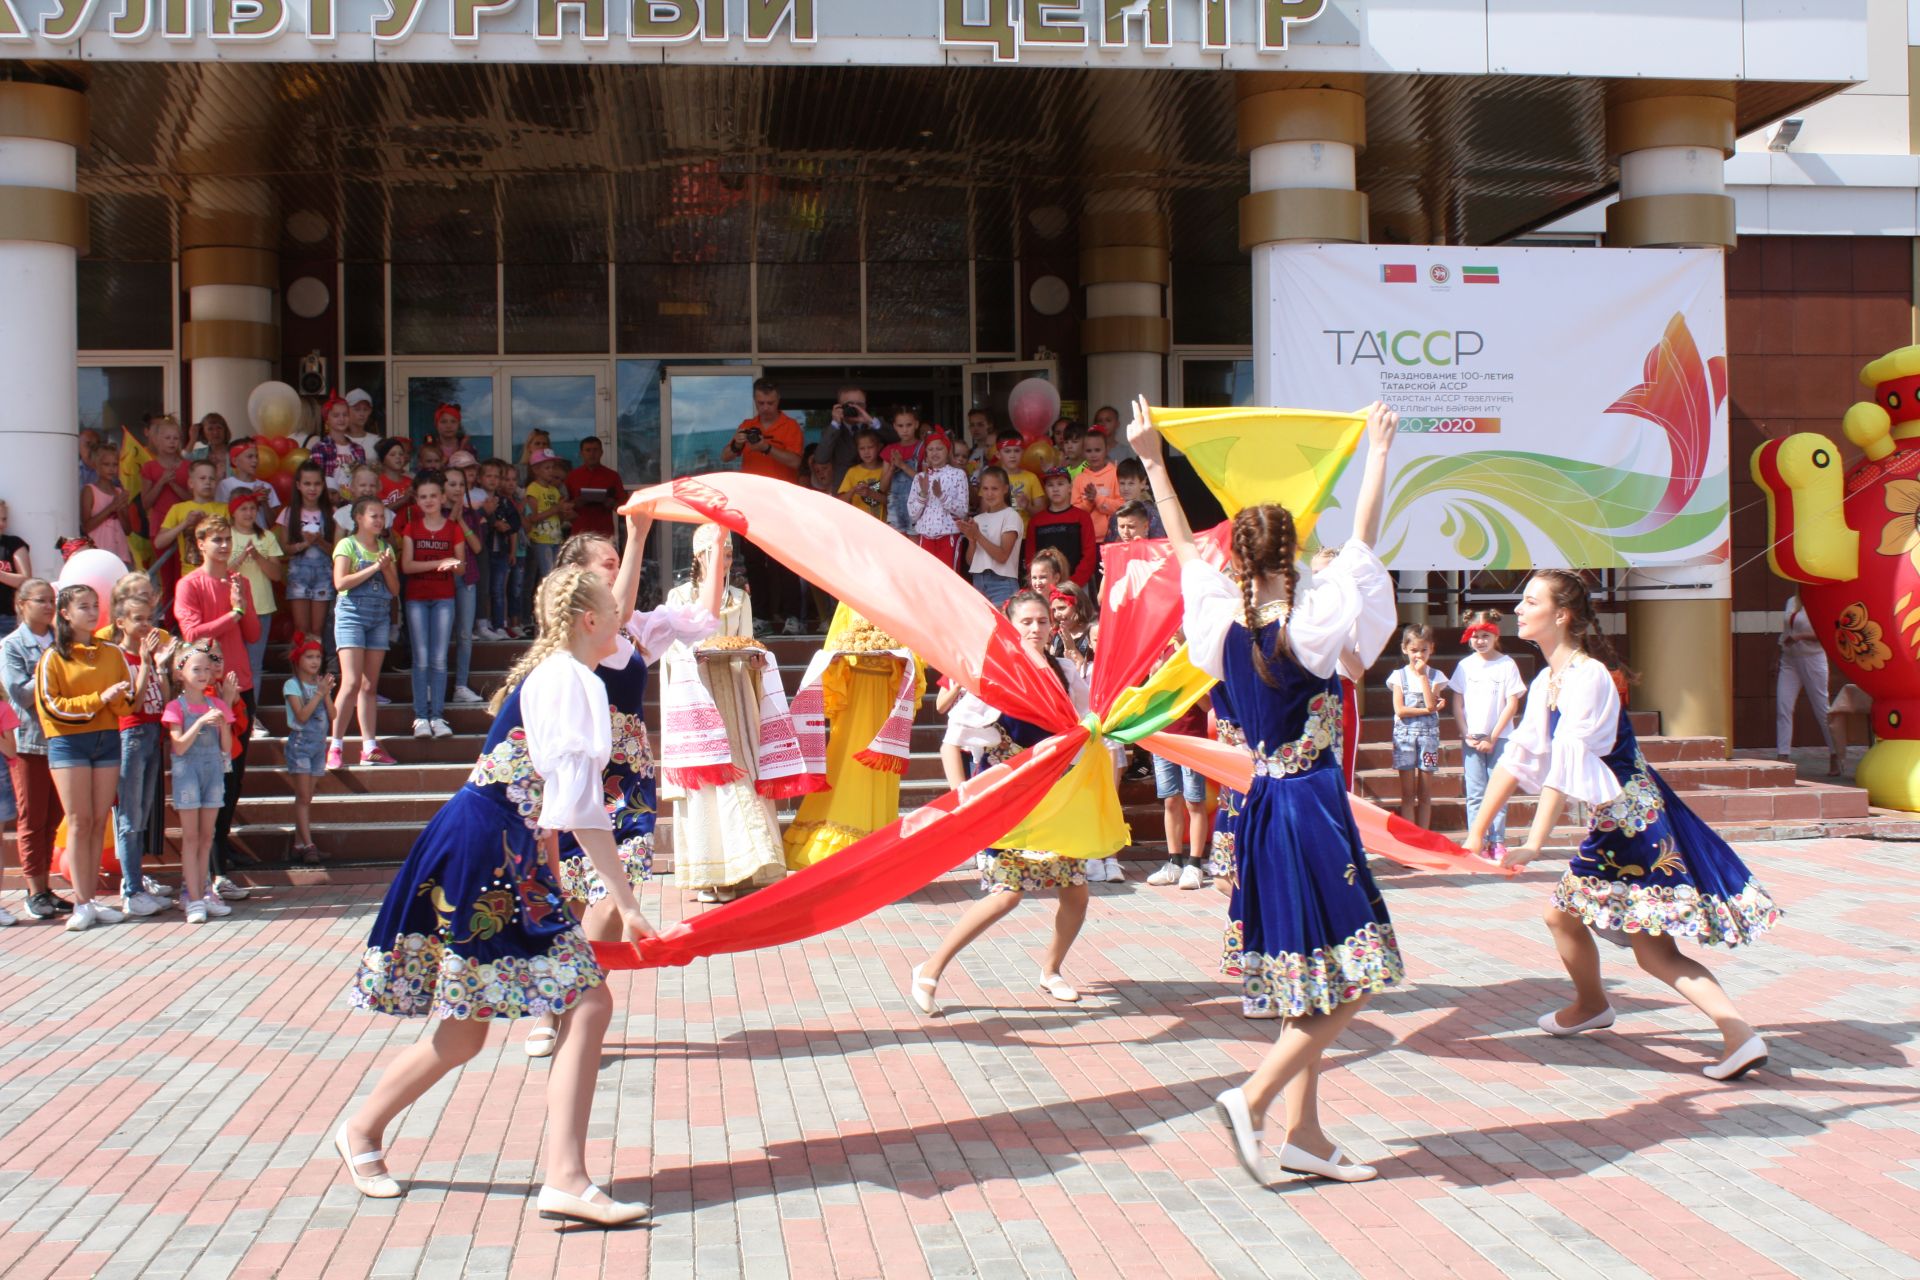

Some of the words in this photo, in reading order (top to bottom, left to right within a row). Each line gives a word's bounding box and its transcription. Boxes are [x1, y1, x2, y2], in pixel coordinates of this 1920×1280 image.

[1440, 382, 1468, 391] АССР
[1435, 394, 1460, 402] АССР
[1399, 417, 1476, 433] 20-2020
[416, 540, 449, 549] BONJOUR
